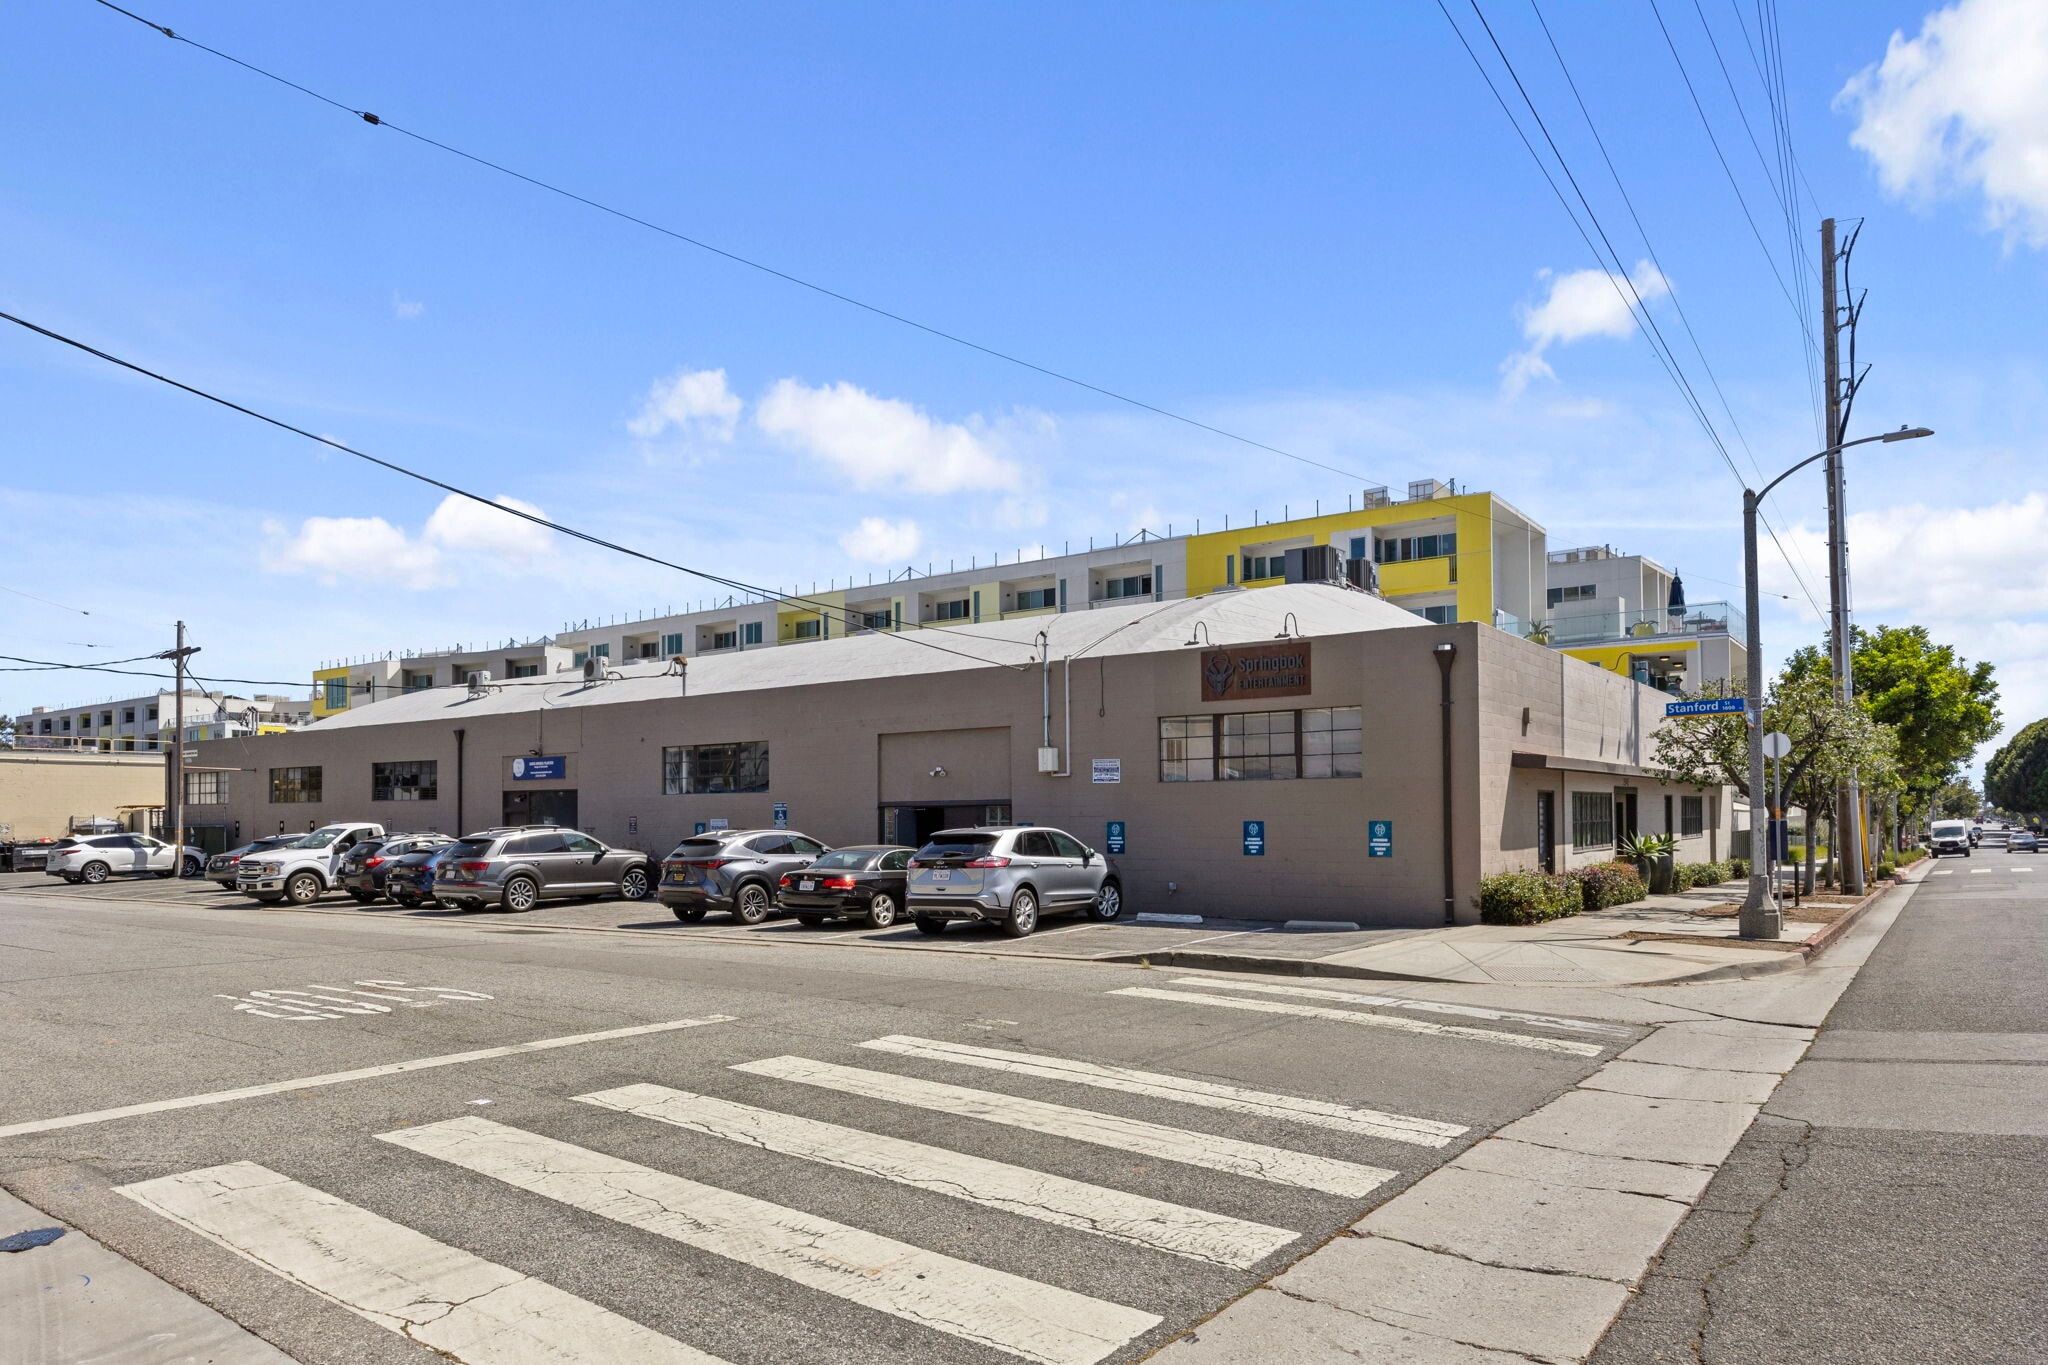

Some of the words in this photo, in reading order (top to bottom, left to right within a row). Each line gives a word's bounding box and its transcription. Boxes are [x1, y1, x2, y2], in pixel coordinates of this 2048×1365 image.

[1238, 652, 1304, 674] Springbok
[1238, 674, 1305, 689] ENTERTAINMENT
[1668, 700, 1719, 714] Stanford
